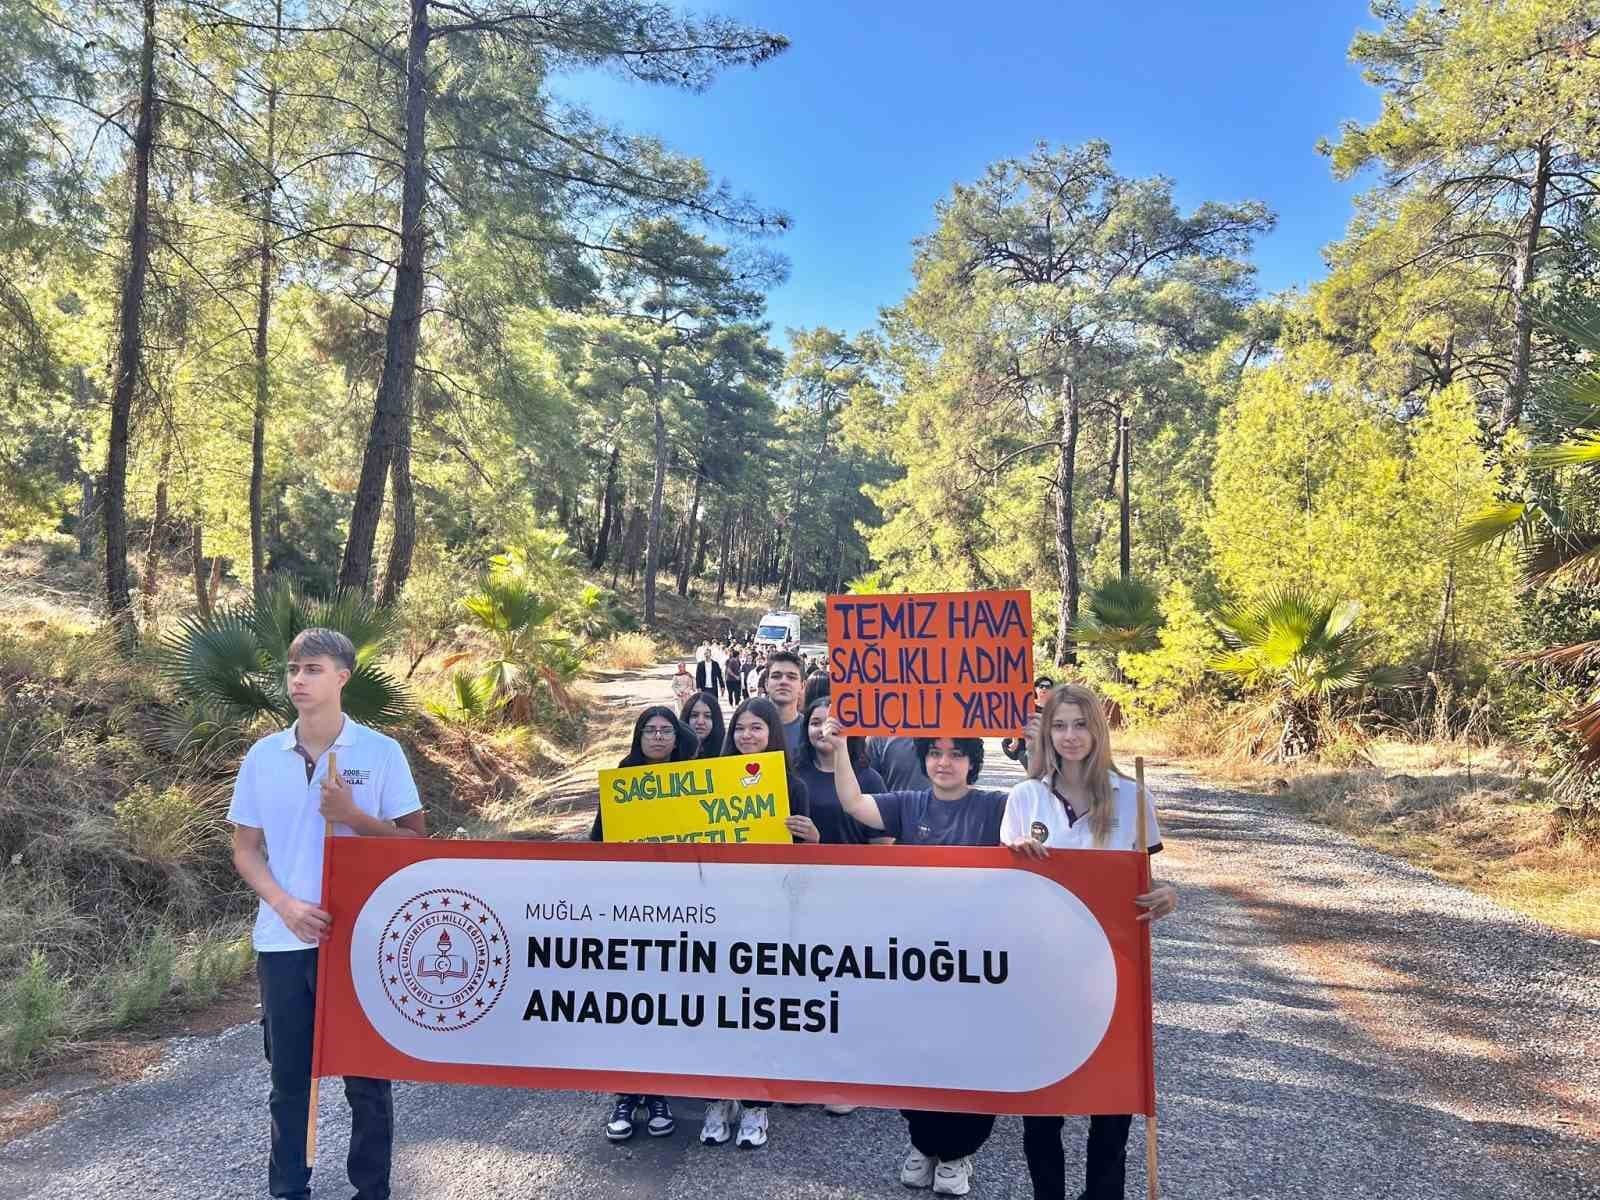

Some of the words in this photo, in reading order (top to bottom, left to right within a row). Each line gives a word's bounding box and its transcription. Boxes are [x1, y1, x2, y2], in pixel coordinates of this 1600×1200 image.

[834, 597, 937, 640] TEMİZ
[949, 600, 1028, 638] HAVA
[831, 643, 947, 684] SAĞLIKLI
[958, 646, 1029, 684] ADIM
[837, 688, 942, 733] GÜÇLÜ
[953, 691, 1032, 729] YARIN
[612, 769, 714, 803] SAĞLIKLI
[700, 794, 775, 824] YAŞAM
[526, 900, 592, 920] MUĞLA
[613, 904, 716, 924] MARMARİS
[401, 915, 440, 968] CUMHURİYETİ
[442, 914, 469, 928] MİLLİ
[467, 924, 486, 957] EĞİTİM
[527, 931, 717, 973] NURETTİN
[729, 937, 1009, 984] GENÇALİOĞLU
[522, 989, 705, 1027] ANADOLU
[718, 987, 839, 1033] LİSESİ
